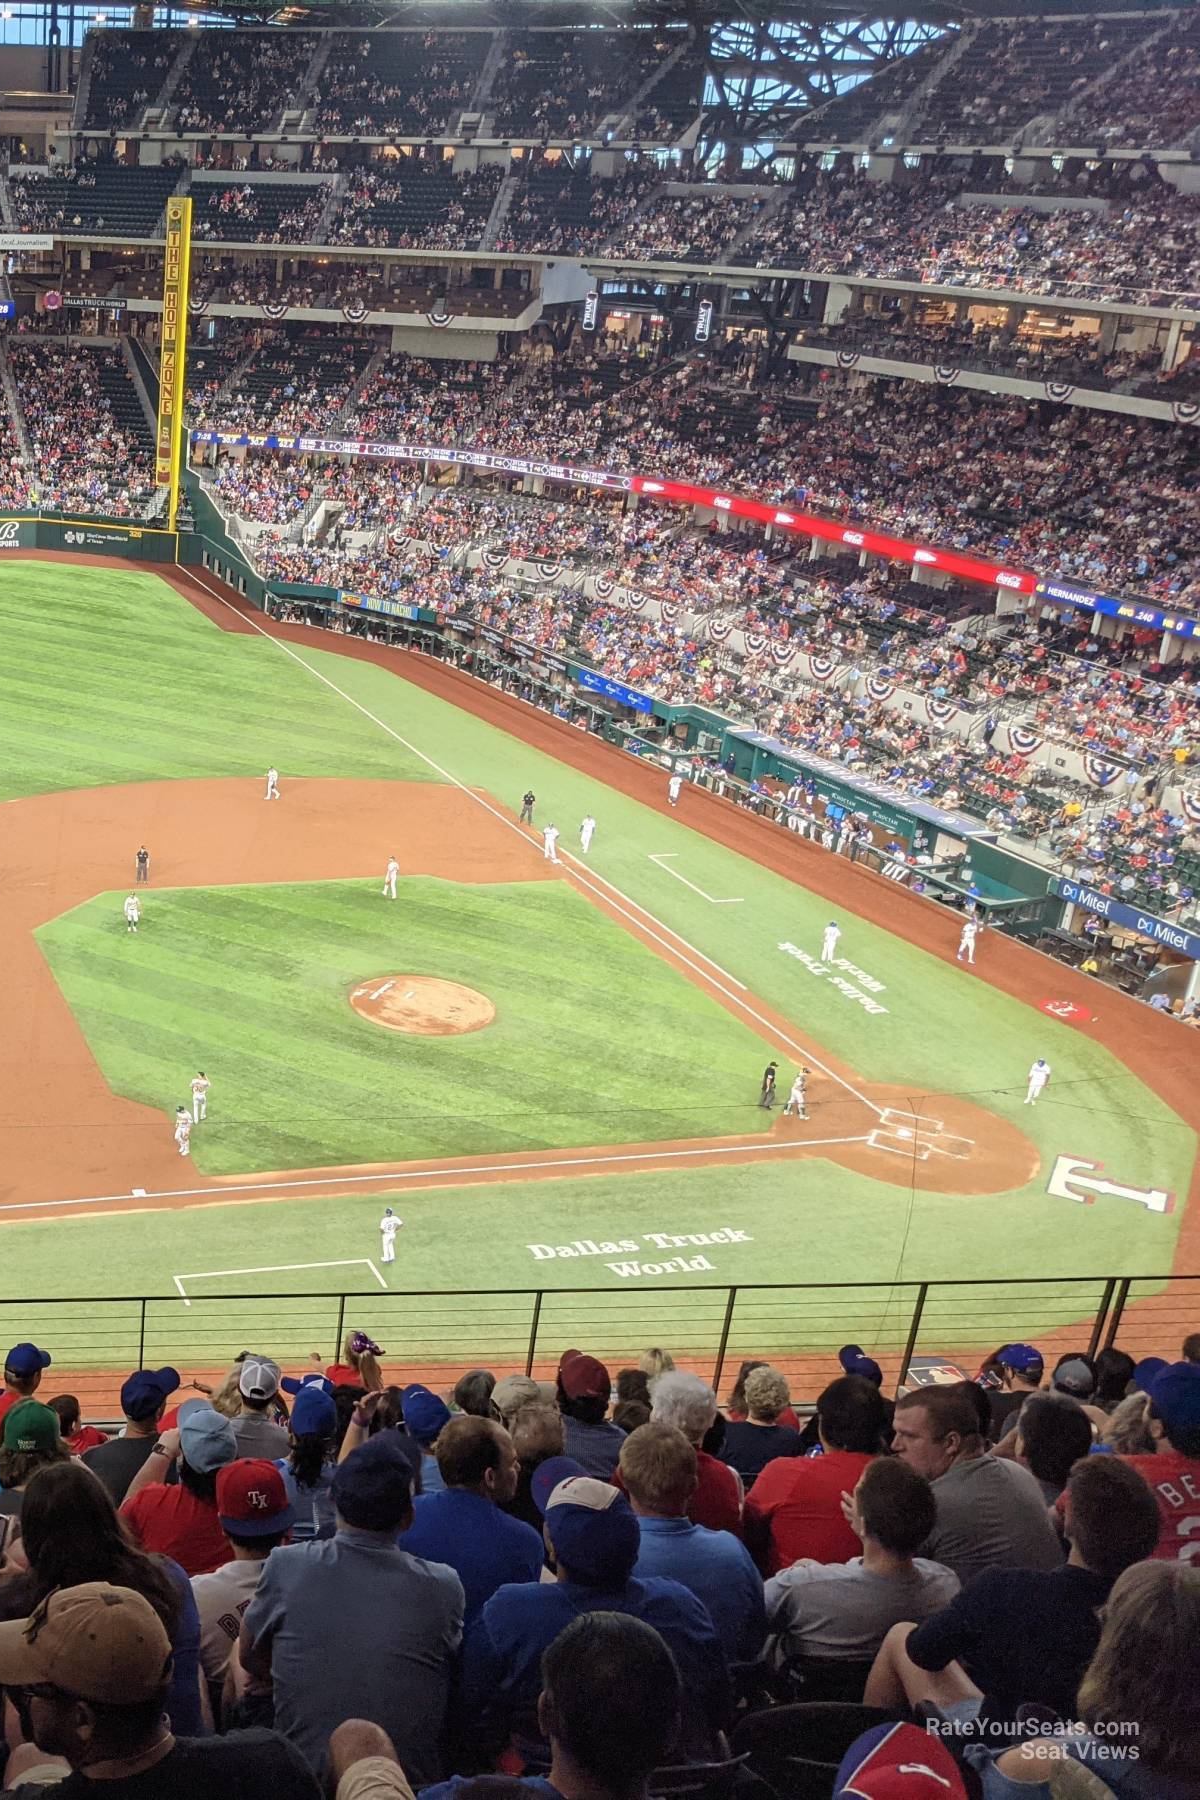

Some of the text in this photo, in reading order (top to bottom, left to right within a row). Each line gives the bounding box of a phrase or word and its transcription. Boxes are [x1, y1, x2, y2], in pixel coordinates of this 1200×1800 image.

[84, 298, 105, 306] TRUCK
[582, 298, 592, 324] TRULY
[162, 232, 180, 414] THE HOT ZONE
[696, 307, 706, 334] TRULY
[1047, 587, 1096, 607] HERNANDEZ
[1078, 892, 1111, 915] Mitel
[1154, 925, 1189, 950] Mitel
[526, 1228, 754, 1260] Dallas Truck
[604, 1255, 717, 1278] World
[248, 1490, 268, 1510] TX
